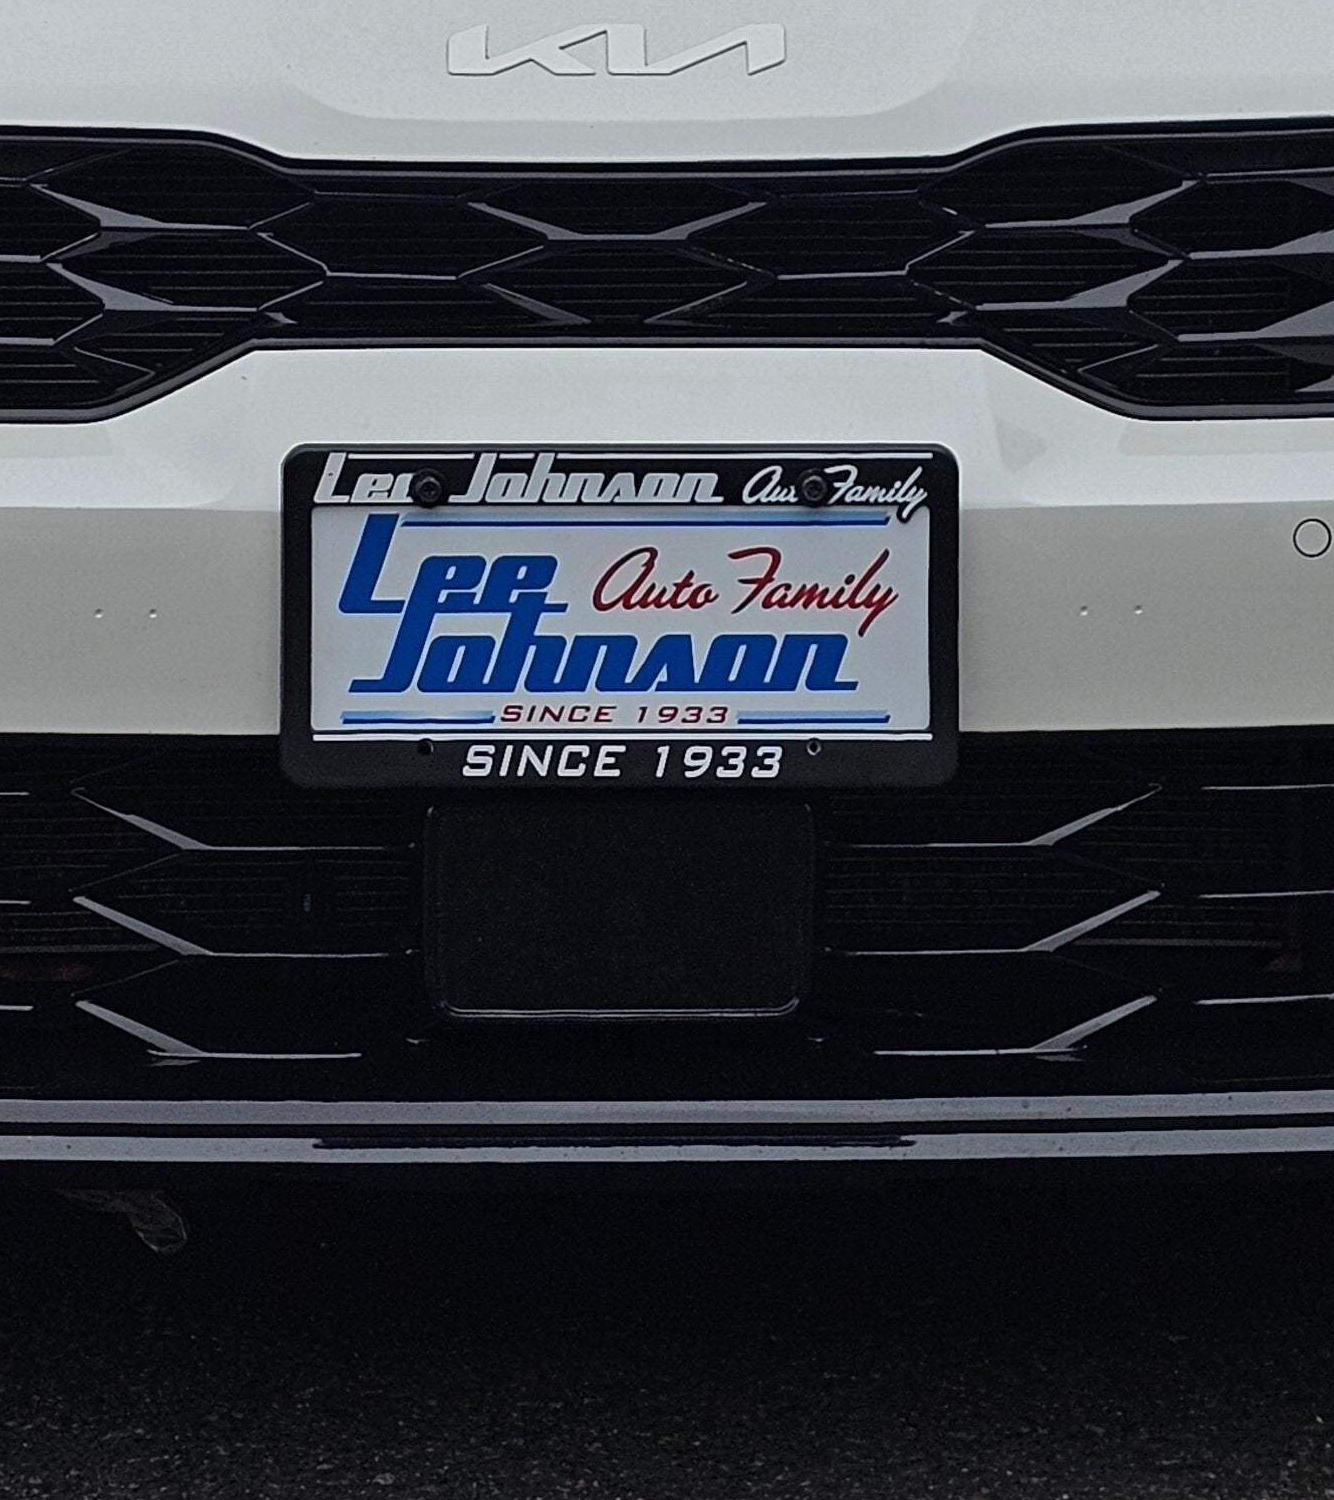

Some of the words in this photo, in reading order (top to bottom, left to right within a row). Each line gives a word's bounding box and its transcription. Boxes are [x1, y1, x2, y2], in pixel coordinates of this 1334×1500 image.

[447, 23, 785, 76] KIA
[448, 452, 724, 503] Johnson
[823, 464, 928, 519] Family
[337, 513, 569, 615] Lee
[592, 546, 720, 612] Auto
[727, 548, 900, 637] Family
[348, 610, 860, 694] Johnson
[500, 705, 617, 723] SINCE
[637, 706, 729, 724] 1933
[462, 745, 627, 778] SINCE
[655, 745, 784, 778] 1933
